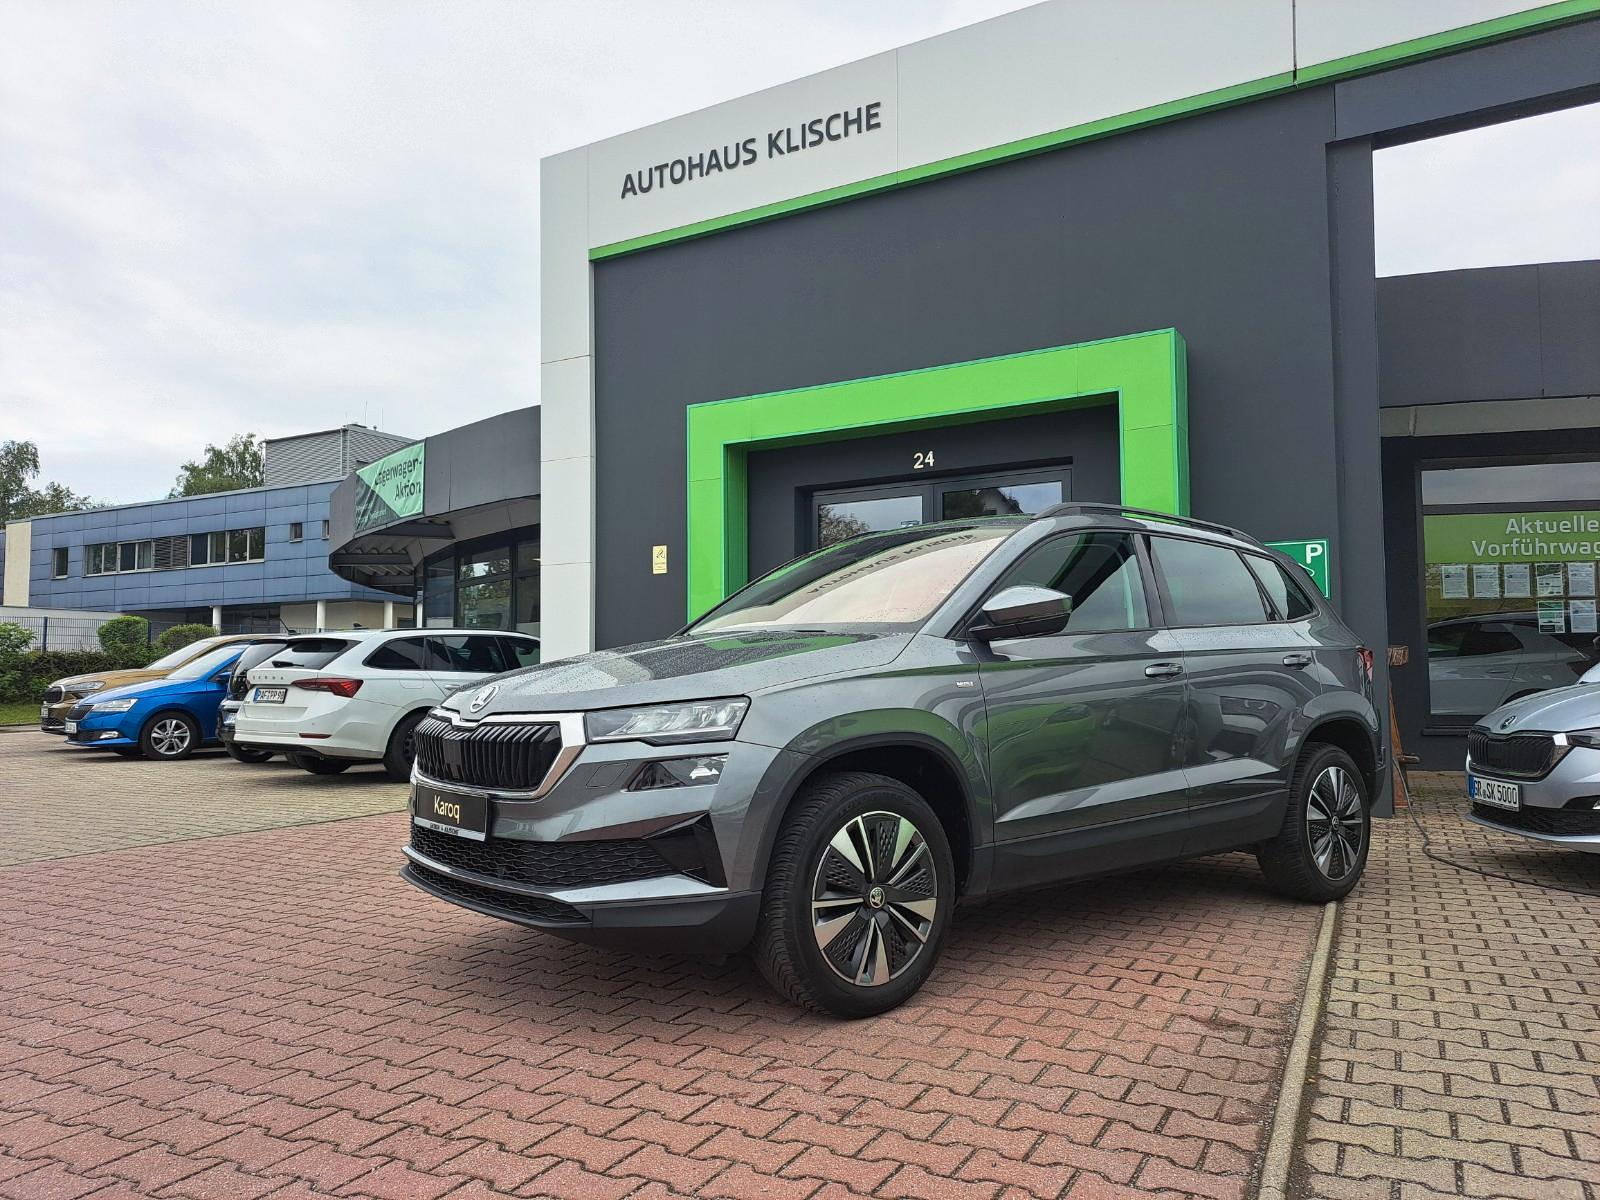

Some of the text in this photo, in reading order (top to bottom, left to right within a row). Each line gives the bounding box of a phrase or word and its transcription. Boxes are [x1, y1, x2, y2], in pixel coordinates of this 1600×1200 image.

[621, 102, 881, 199] AUTOHAUS KLISCHE
[913, 450, 935, 469] 24
[395, 479, 422, 500] Aktion
[1505, 515, 1599, 534] Aktuelle
[1305, 544, 1323, 564] P
[433, 794, 460, 824] Karoq
